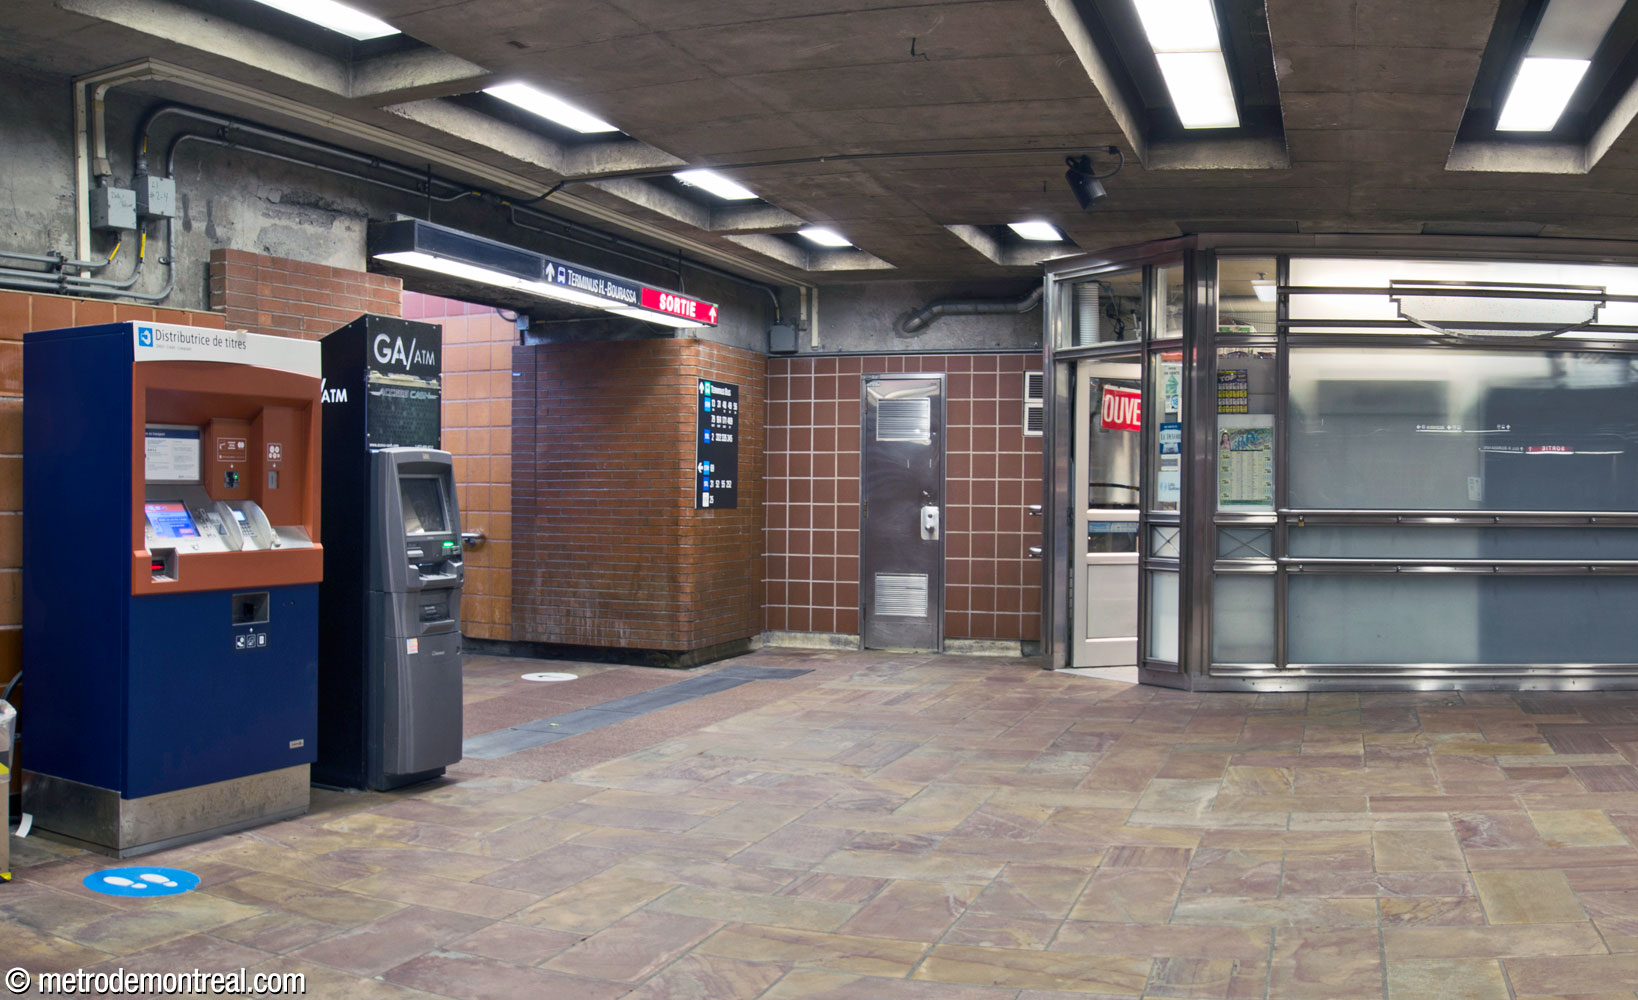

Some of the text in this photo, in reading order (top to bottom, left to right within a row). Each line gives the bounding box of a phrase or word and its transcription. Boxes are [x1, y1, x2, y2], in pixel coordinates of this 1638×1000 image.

[568, 269, 599, 293] TERMINUS
[659, 293, 696, 317] SORTIE
[155, 329, 246, 350] Distributrice de titres
[1103, 394, 1141, 425] OUVE
